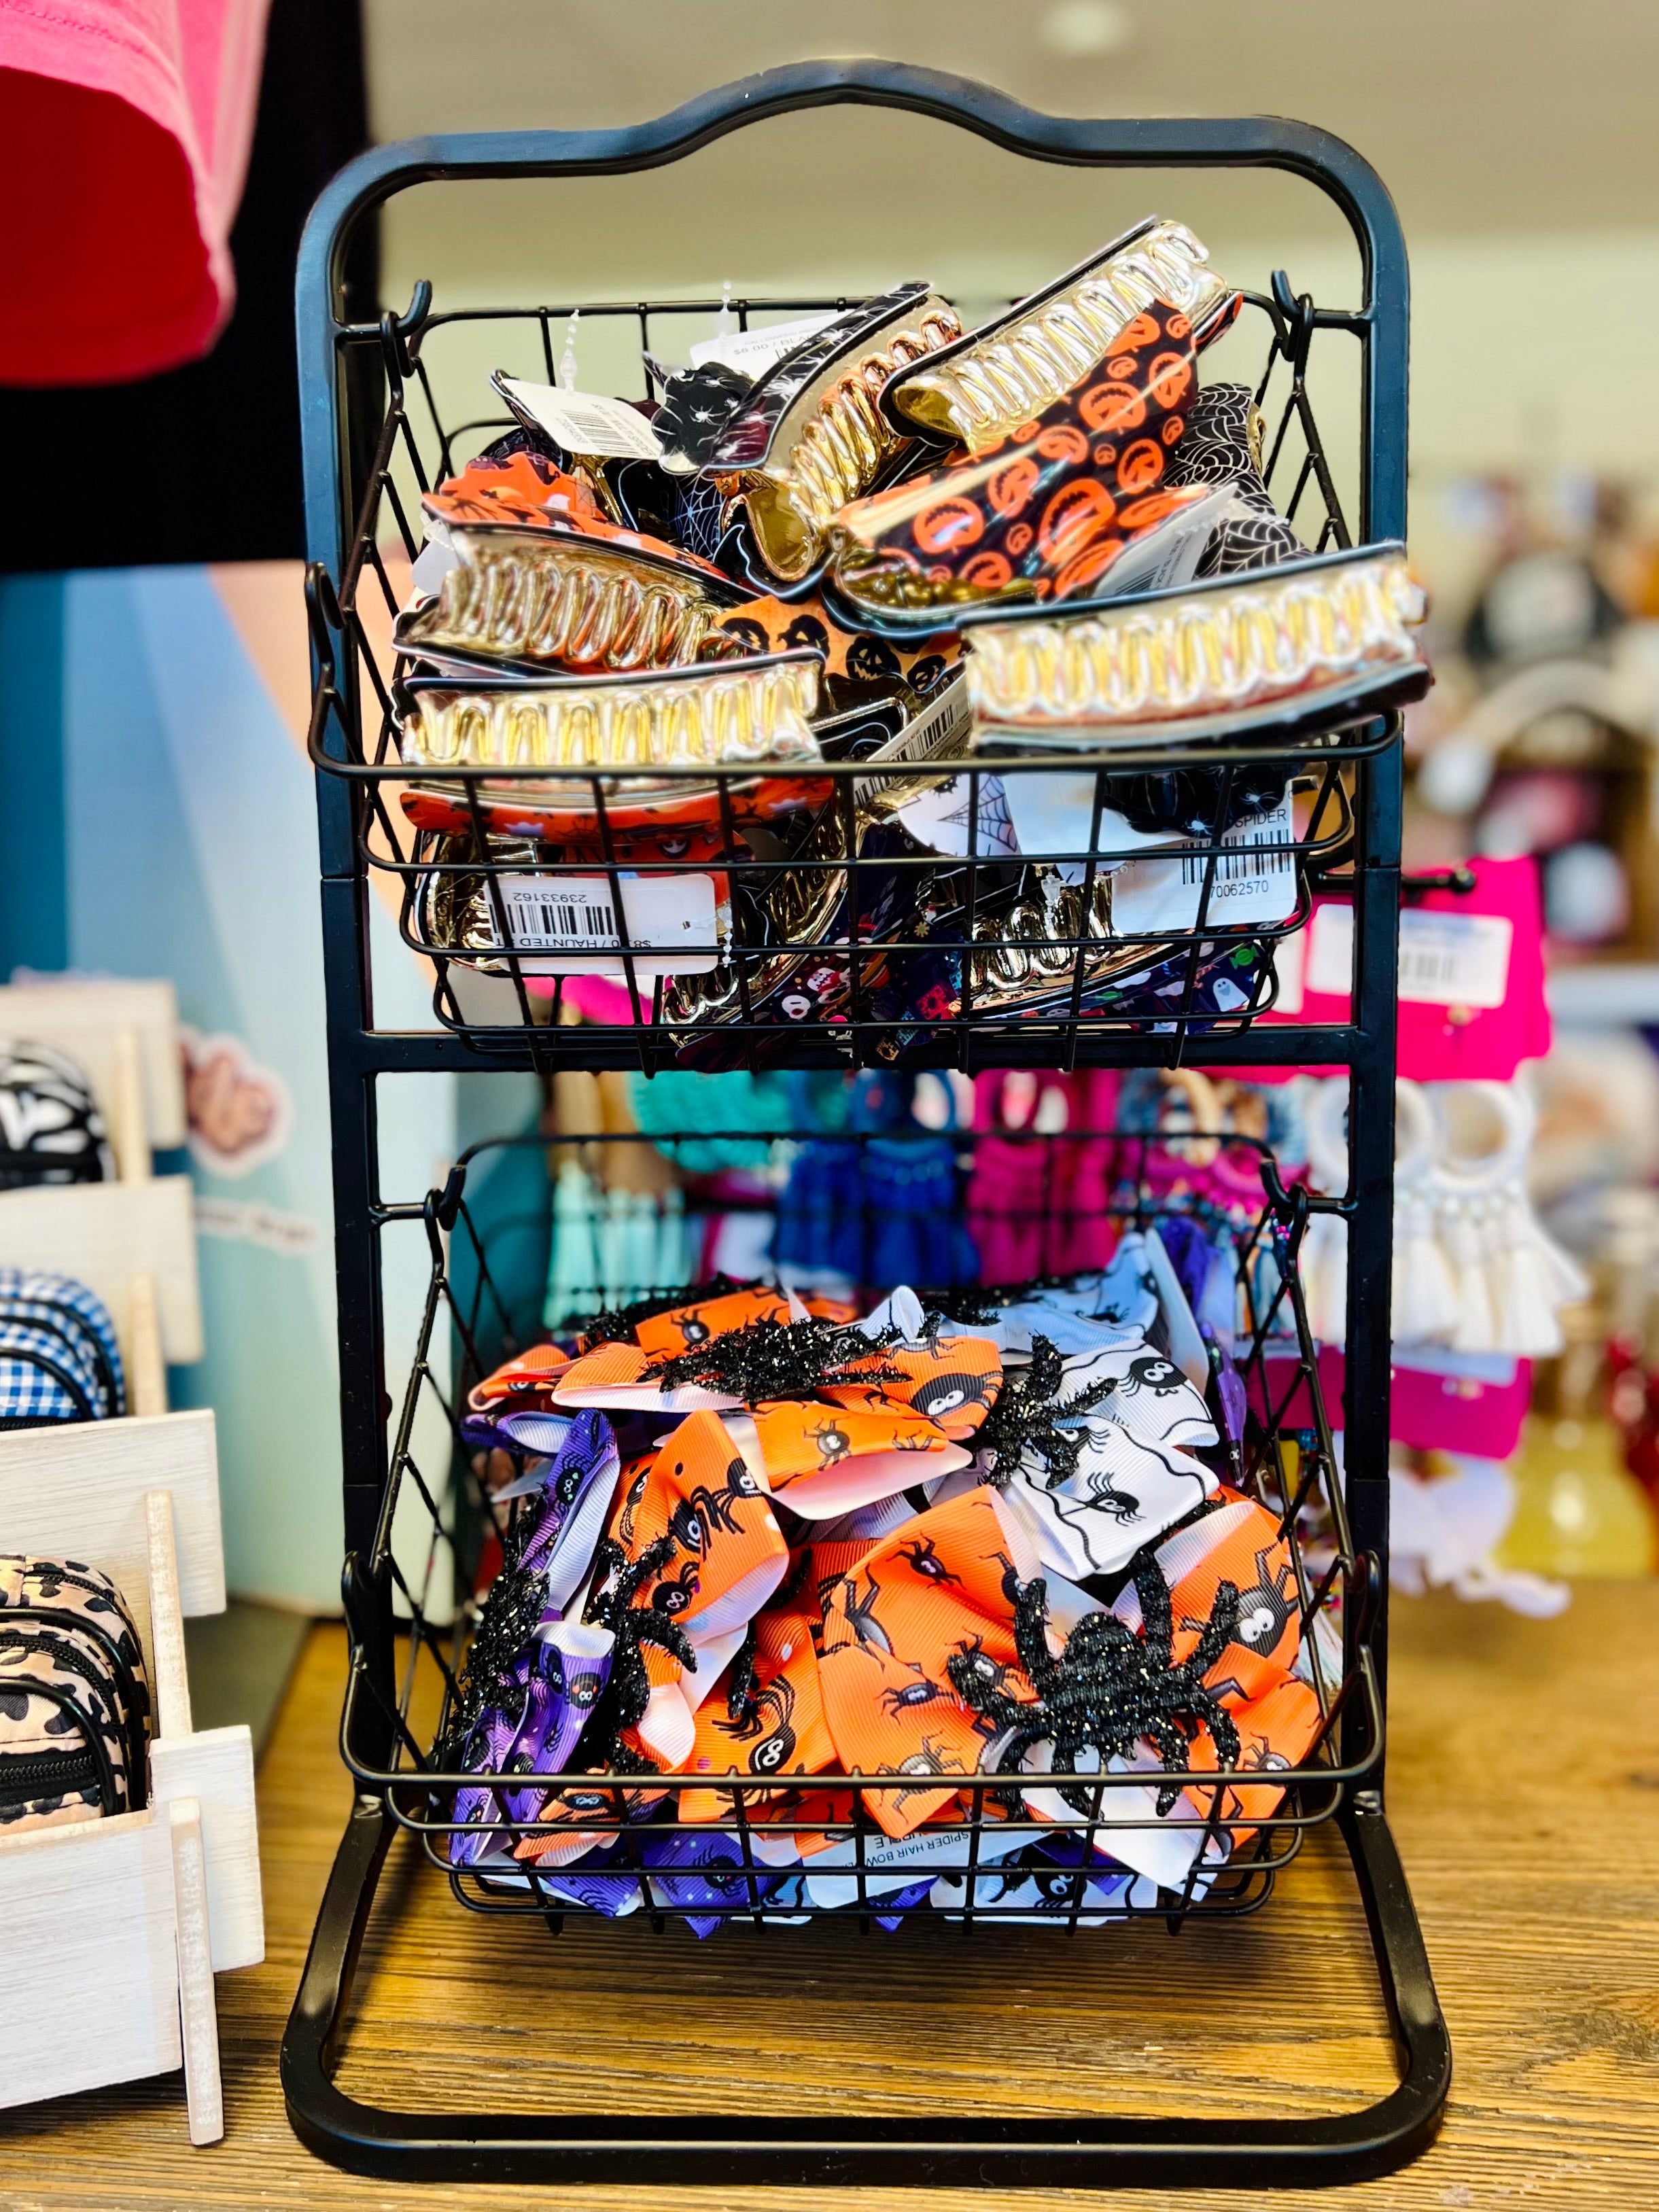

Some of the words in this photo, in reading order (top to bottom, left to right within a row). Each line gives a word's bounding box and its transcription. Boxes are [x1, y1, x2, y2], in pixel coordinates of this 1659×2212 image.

[1234, 809, 1287, 828] SPIDER
[1210, 880, 1269, 898] 70062570
[513, 892, 587, 903] 23933162
[520, 938, 597, 948] HAUNTED
[927, 1831, 969, 1850] SPIDER
[866, 1851, 894, 1867] BOW
[897, 1844, 924, 1859] HAIR
